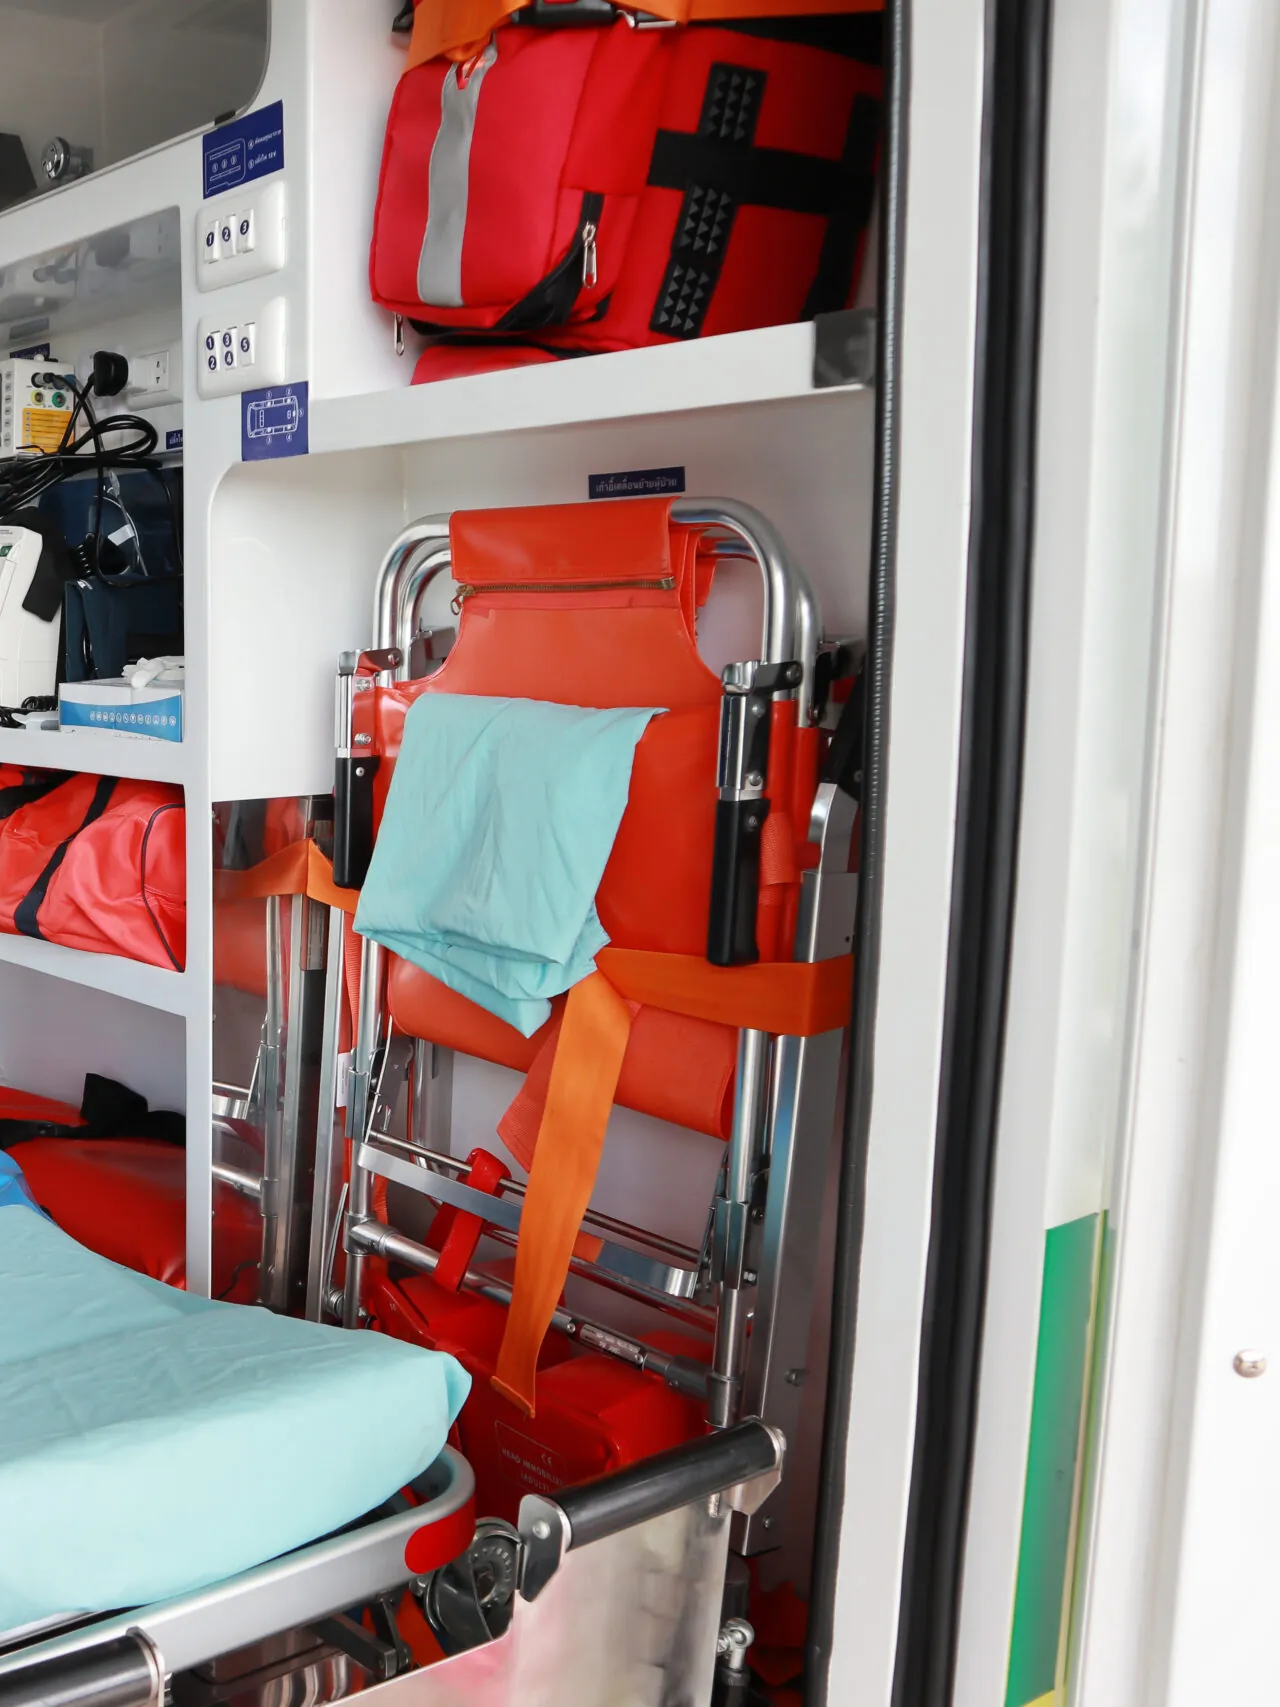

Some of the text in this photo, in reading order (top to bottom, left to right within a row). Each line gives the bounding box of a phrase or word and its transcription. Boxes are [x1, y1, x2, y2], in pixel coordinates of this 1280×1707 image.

[207, 221, 248, 245] 1 2 3
[207, 334, 249, 350] 1 3 5
[209, 352, 232, 369] 2 4
[502, 1447, 521, 1463] HEAD
